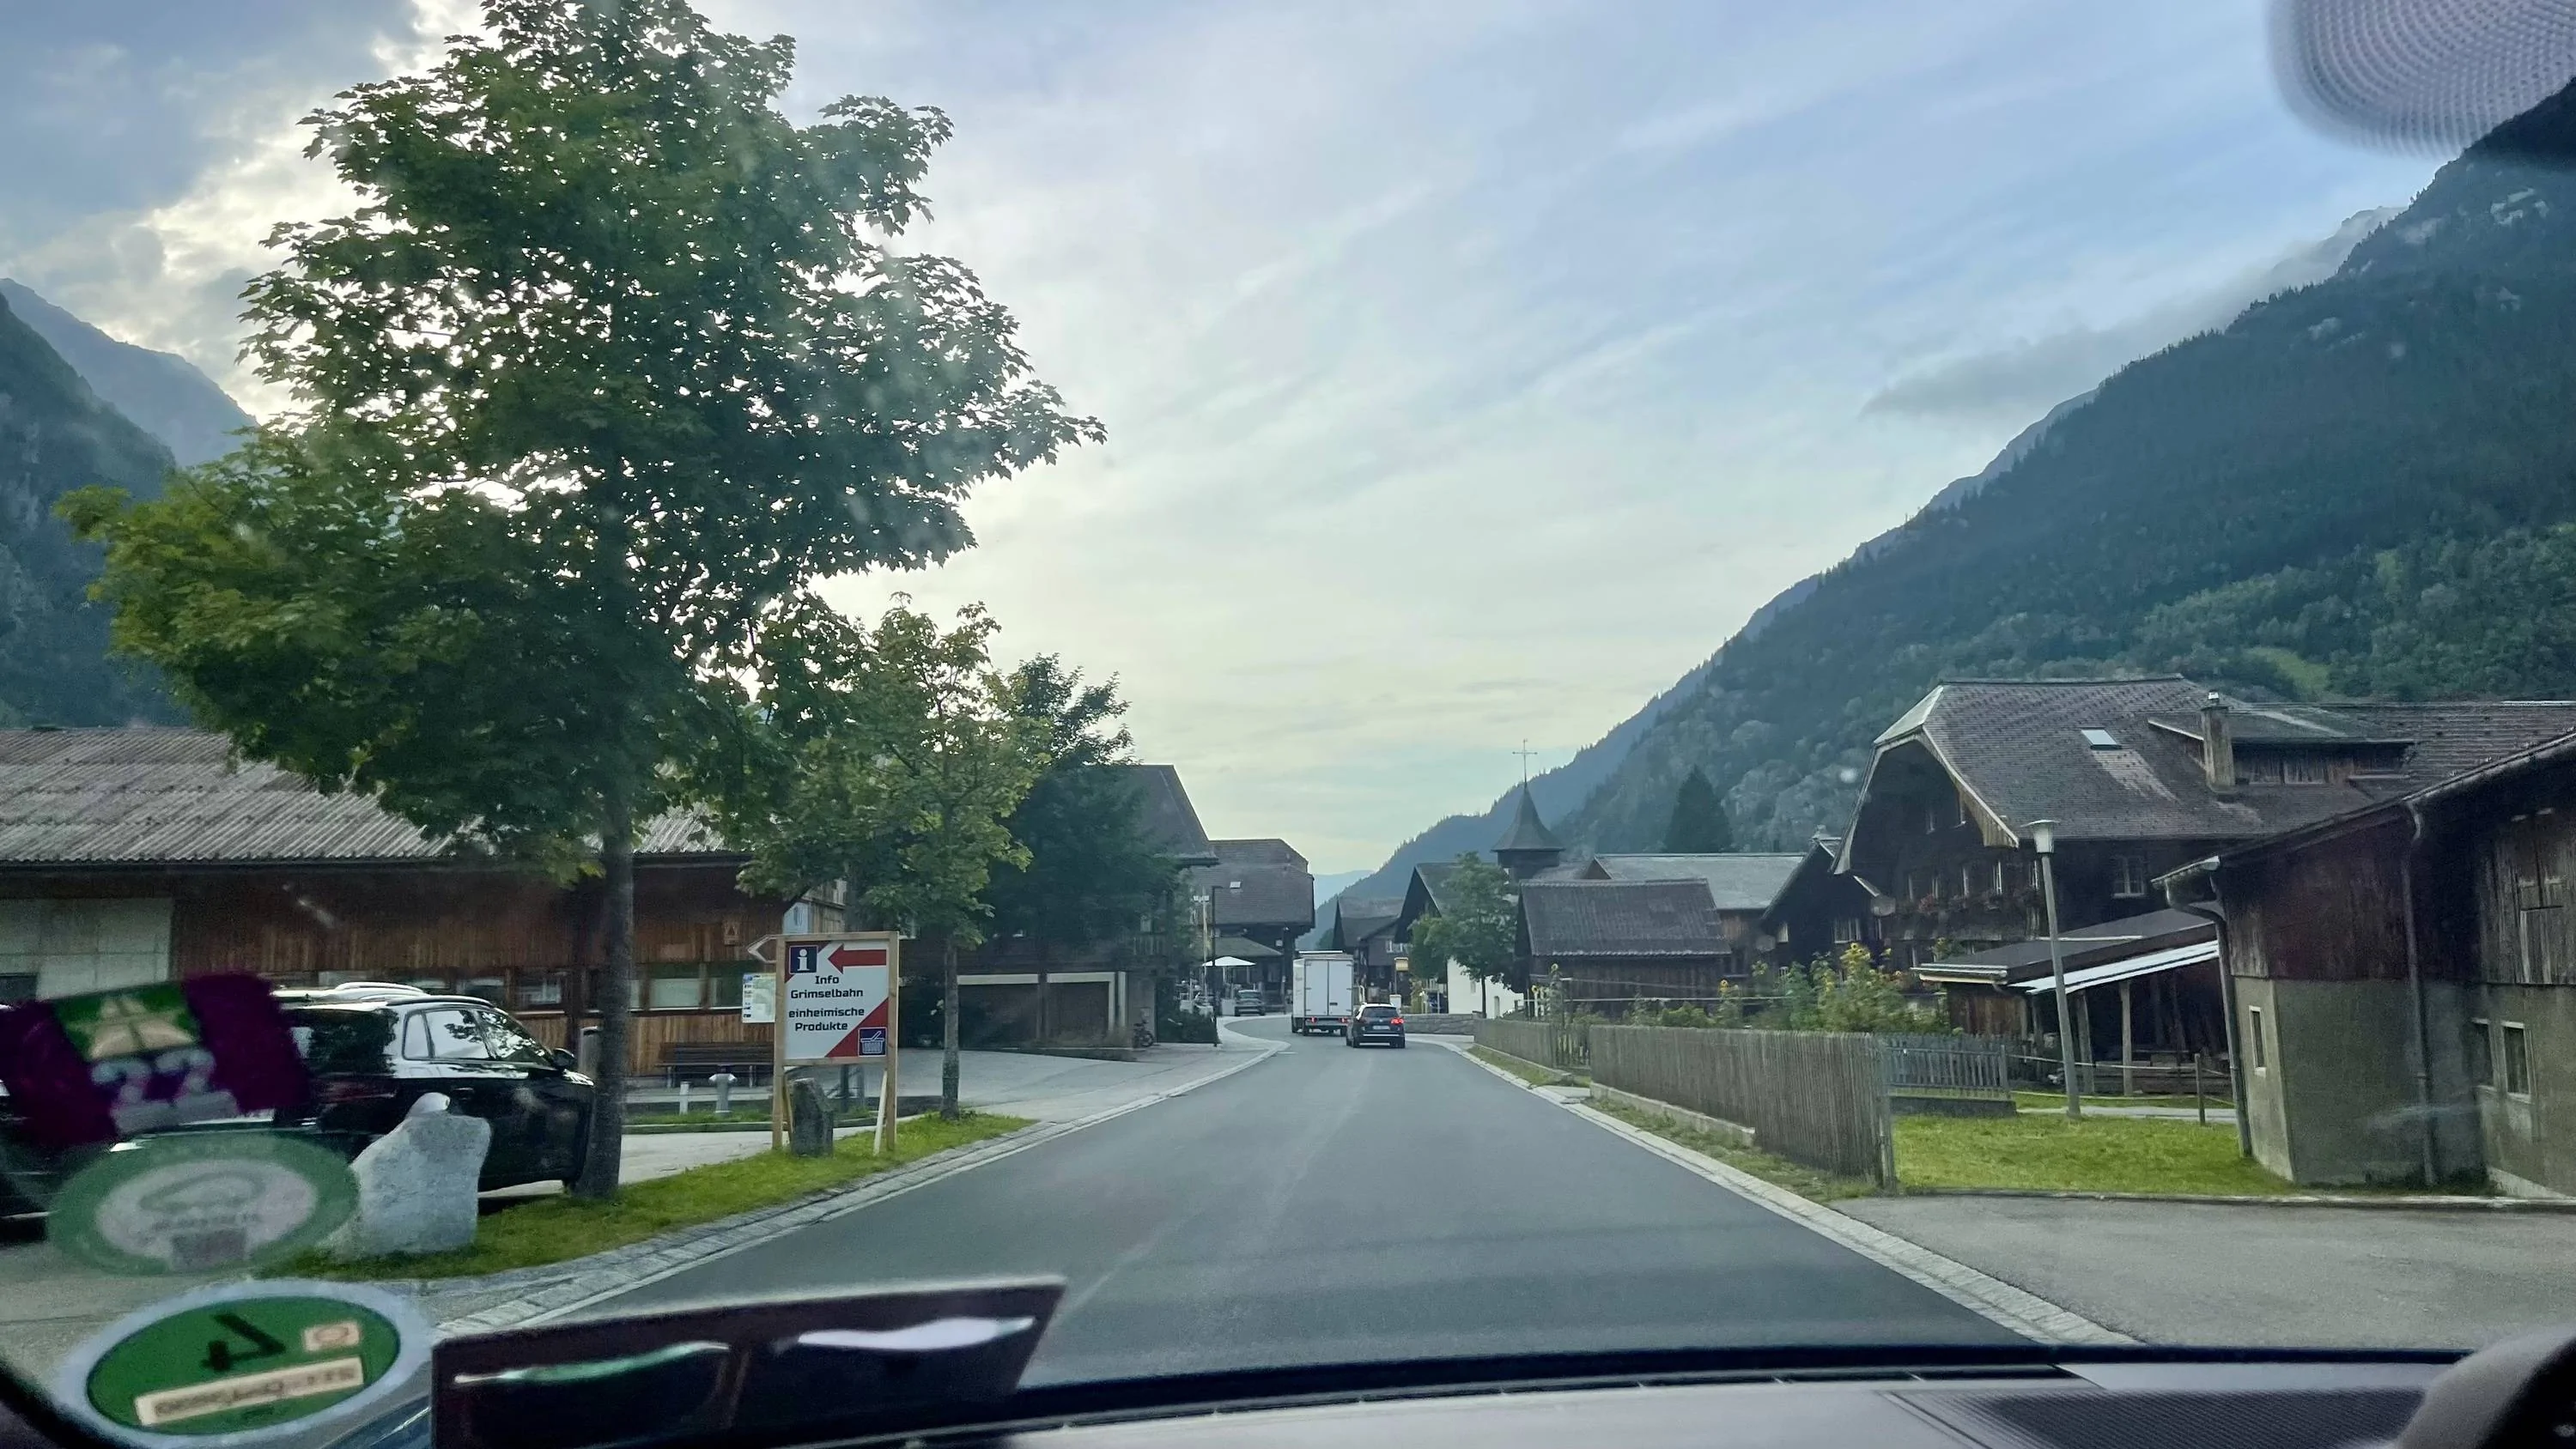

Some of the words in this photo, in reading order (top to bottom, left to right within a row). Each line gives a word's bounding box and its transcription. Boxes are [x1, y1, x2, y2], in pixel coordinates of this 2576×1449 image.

[815, 975, 840, 985] Info
[790, 988, 864, 999] Grimselbahn
[788, 1007, 865, 1018] einheimische
[795, 1022, 848, 1032] Produkte
